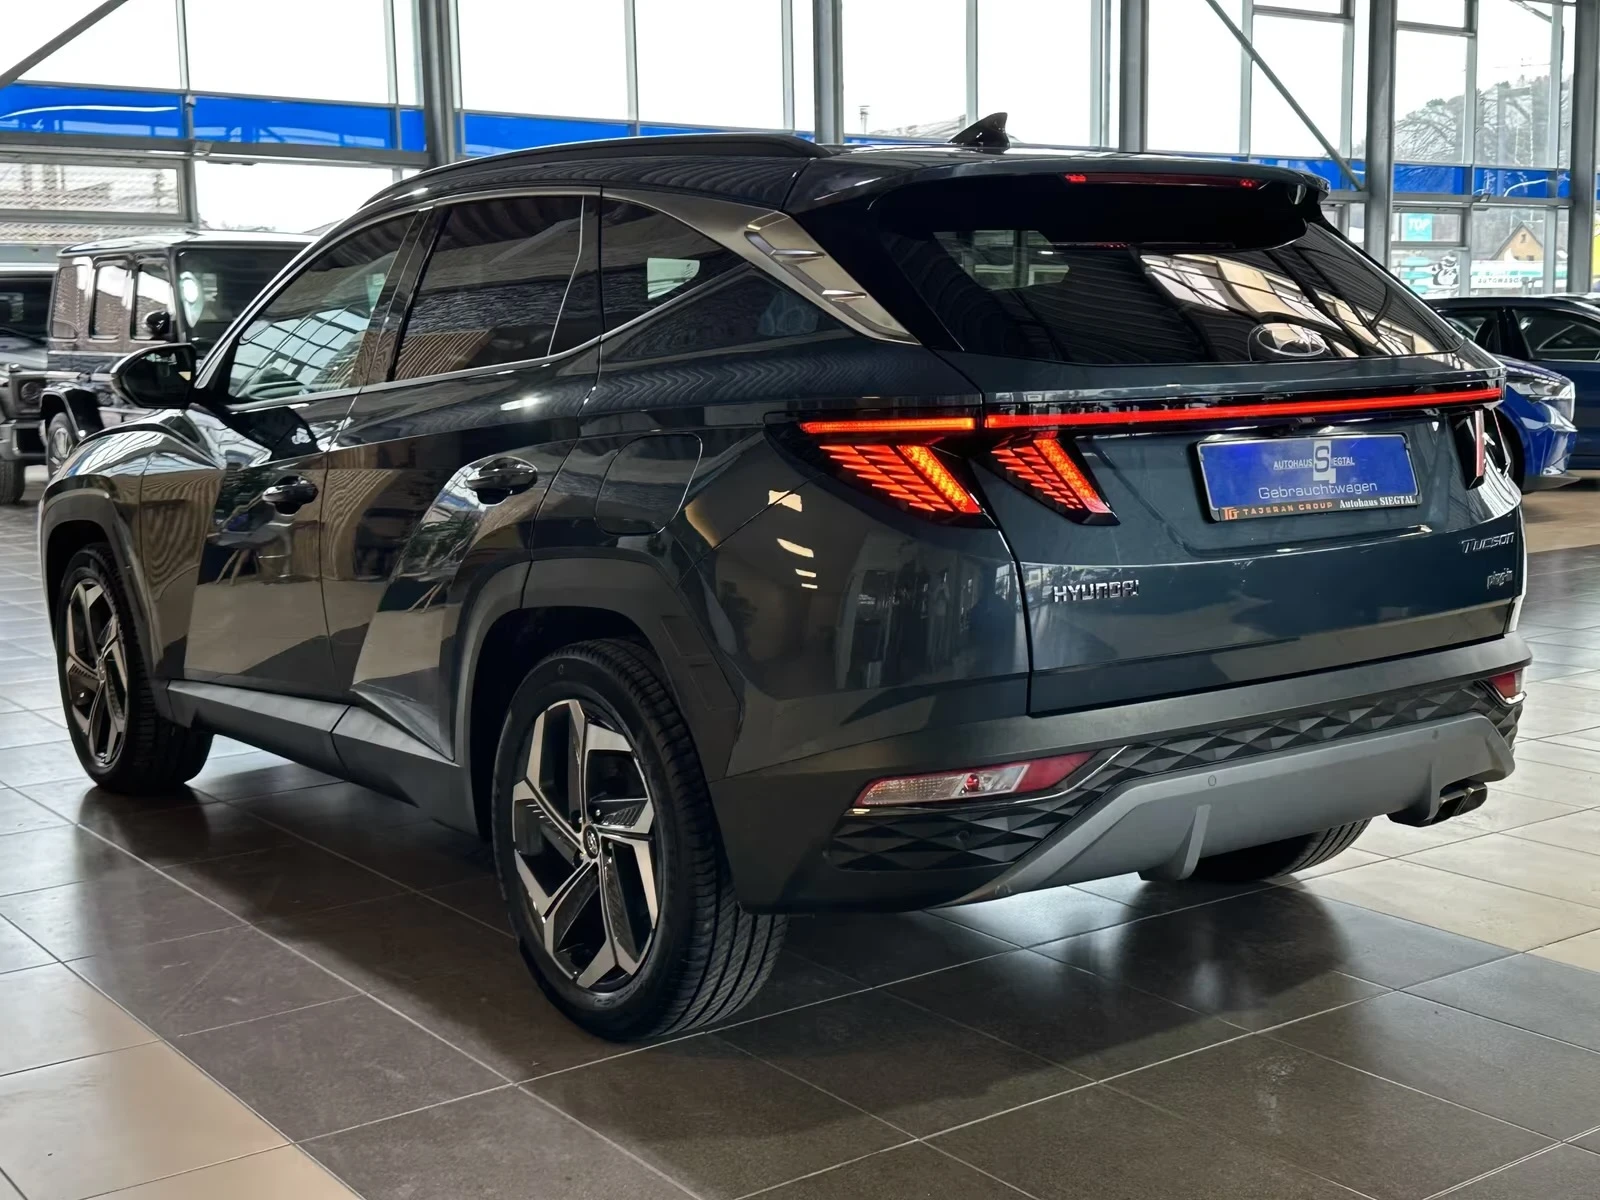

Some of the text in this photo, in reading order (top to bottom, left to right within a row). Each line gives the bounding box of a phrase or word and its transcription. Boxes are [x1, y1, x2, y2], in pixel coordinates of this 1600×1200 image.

[1273, 458, 1313, 471] AUTOHAUS
[1258, 482, 1378, 500] Gebrauchtwagen
[1298, 501, 1333, 511] GROUP
[1339, 495, 1416, 509] Autohaus SIEGTAL
[1053, 579, 1139, 603] HYUNDAI
